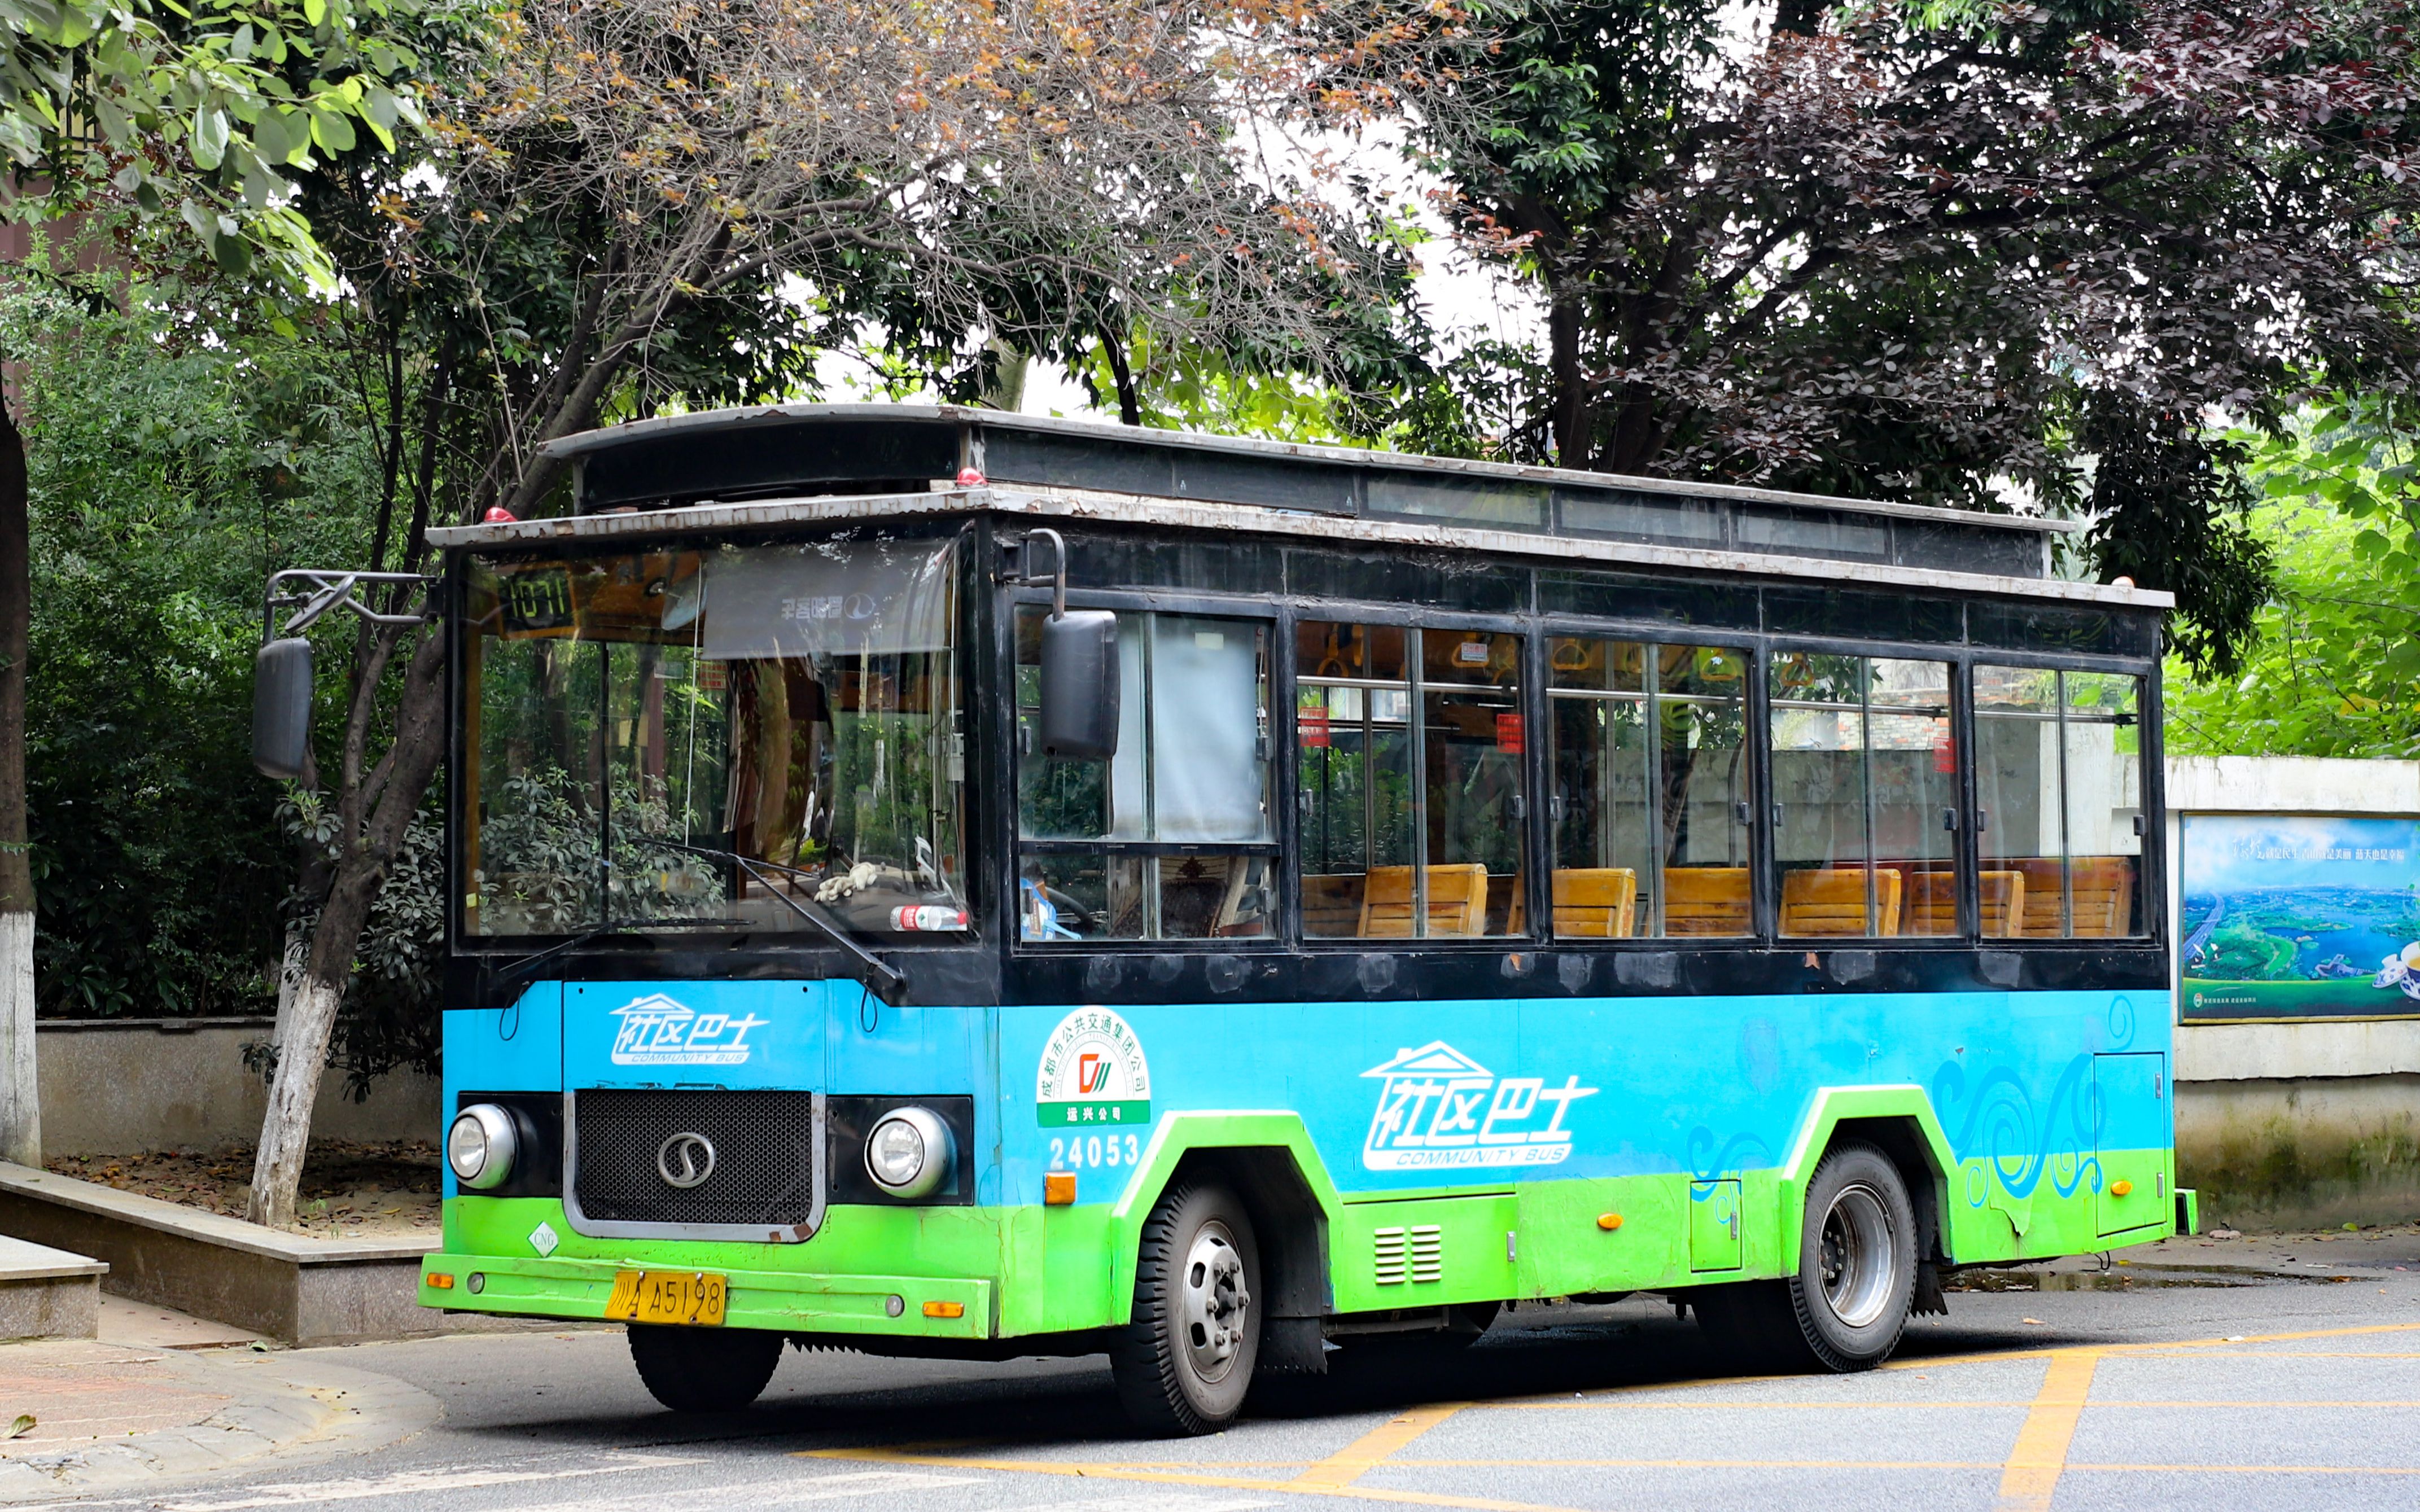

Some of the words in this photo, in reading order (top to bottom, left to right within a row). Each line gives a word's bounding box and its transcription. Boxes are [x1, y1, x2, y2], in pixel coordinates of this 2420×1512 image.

[510, 577, 564, 617] 1071
[618, 1013, 771, 1052] 社区巴士
[632, 1054, 712, 1062] COMMUNITY
[716, 1054, 745, 1062] BUS
[1041, 1013, 1146, 1098] 成都市公共交通集团公司
[1066, 1106, 1121, 1121] 运兴公司
[1375, 1075, 1599, 1148] 社区巴士
[1050, 1134, 1138, 1170] 24053
[1397, 1149, 1520, 1165] COMMUNITY
[1525, 1147, 1565, 1162] BUS
[534, 1233, 554, 1246] CNG
